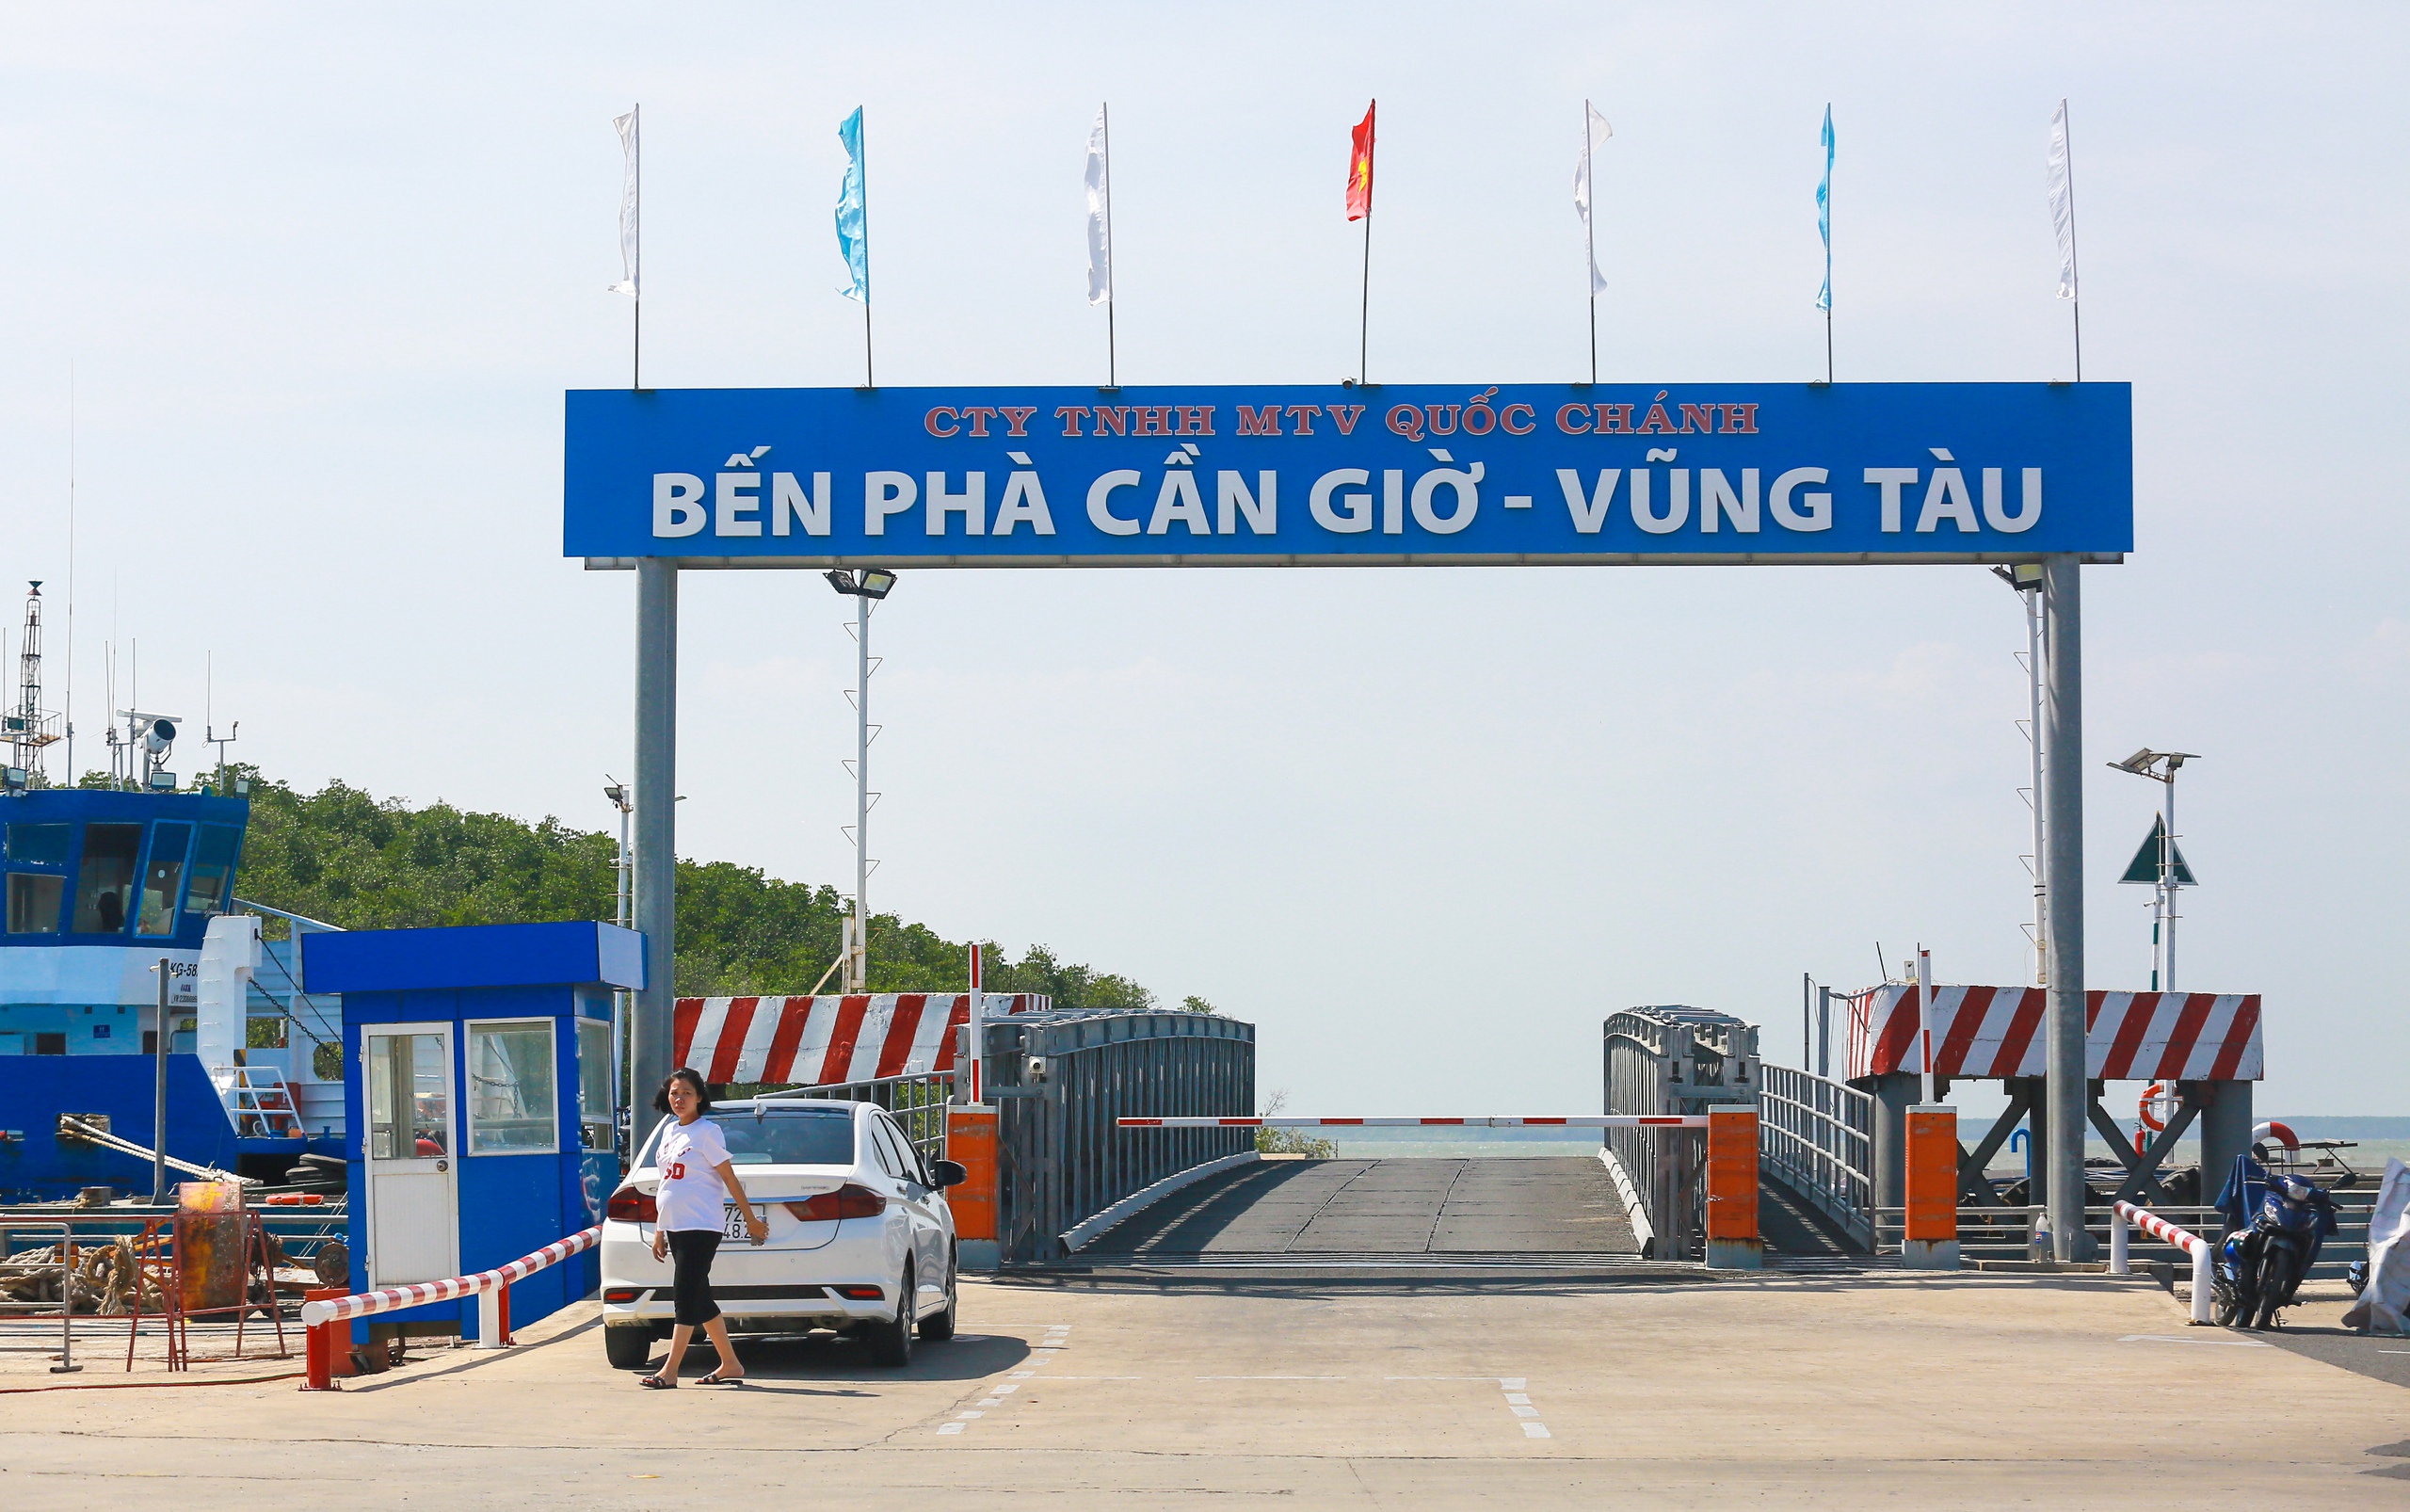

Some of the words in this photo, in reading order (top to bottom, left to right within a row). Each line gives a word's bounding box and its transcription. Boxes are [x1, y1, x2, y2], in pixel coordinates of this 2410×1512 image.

[924, 406, 1037, 437] CTY
[1054, 405, 1216, 437] TNHH
[1236, 405, 1366, 436] MTV
[1385, 386, 1536, 442] QUỐC
[1555, 390, 1759, 435] CHÁNH
[652, 445, 831, 538] BẾN
[864, 451, 1056, 536] PHÀ
[1085, 442, 1277, 535] CẦN
[1309, 448, 1486, 535] GIỜ
[1503, 495, 1533, 508] -
[1555, 447, 1832, 534] VŨNG
[1863, 447, 2043, 533] TÀU
[170, 962, 198, 977] KG-58
[724, 1207, 746, 1222] 72
